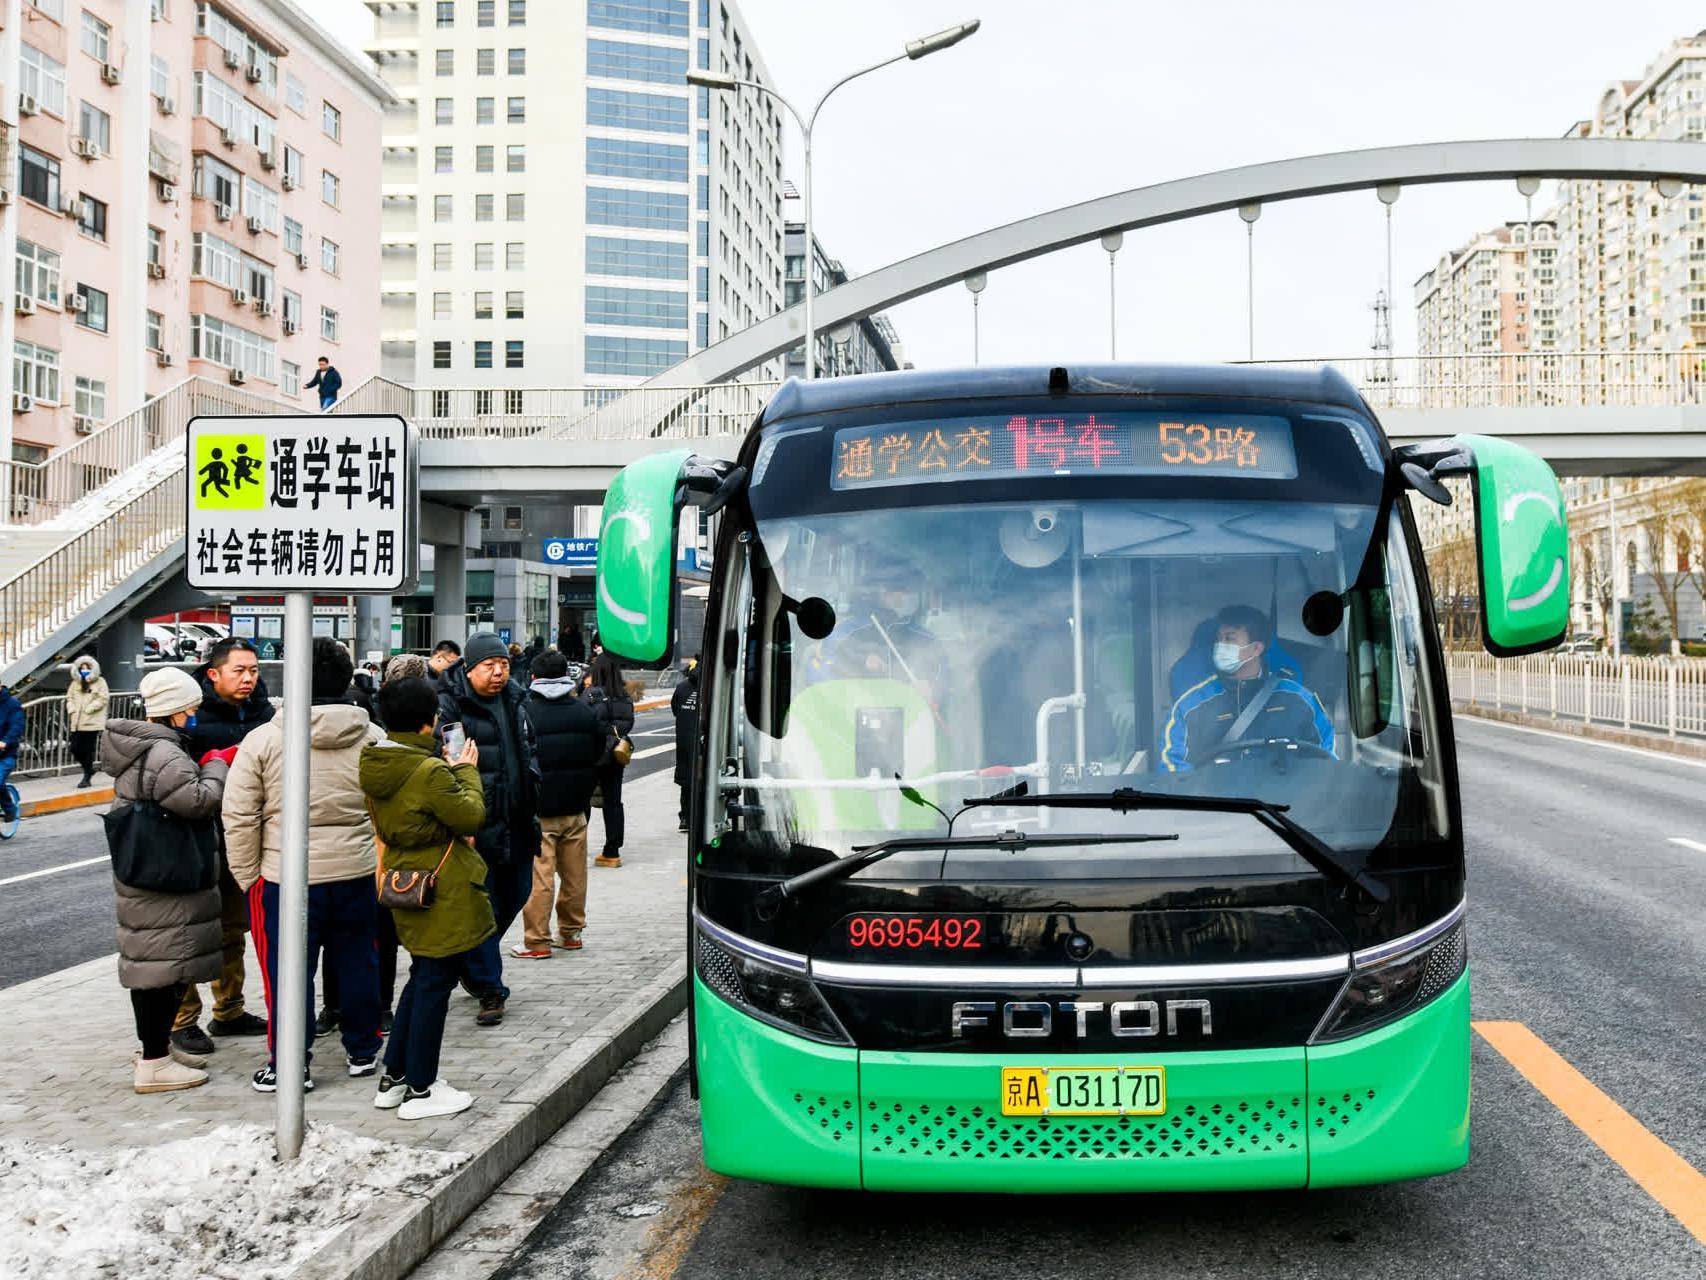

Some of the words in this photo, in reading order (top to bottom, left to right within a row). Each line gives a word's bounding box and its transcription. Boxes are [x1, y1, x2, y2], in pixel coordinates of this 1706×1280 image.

[838, 427, 991, 478] 通学公交
[1006, 415, 1121, 472] 1号车
[1158, 422, 1261, 467] 53路
[270, 436, 396, 511] 通学车站
[197, 527, 394, 577] 社会车辆请勿占用
[849, 917, 983, 948] 9695492
[951, 998, 1213, 1038] FOTON
[1007, 1075, 1040, 1107] 京A
[1056, 1075, 1160, 1108] 03117D
